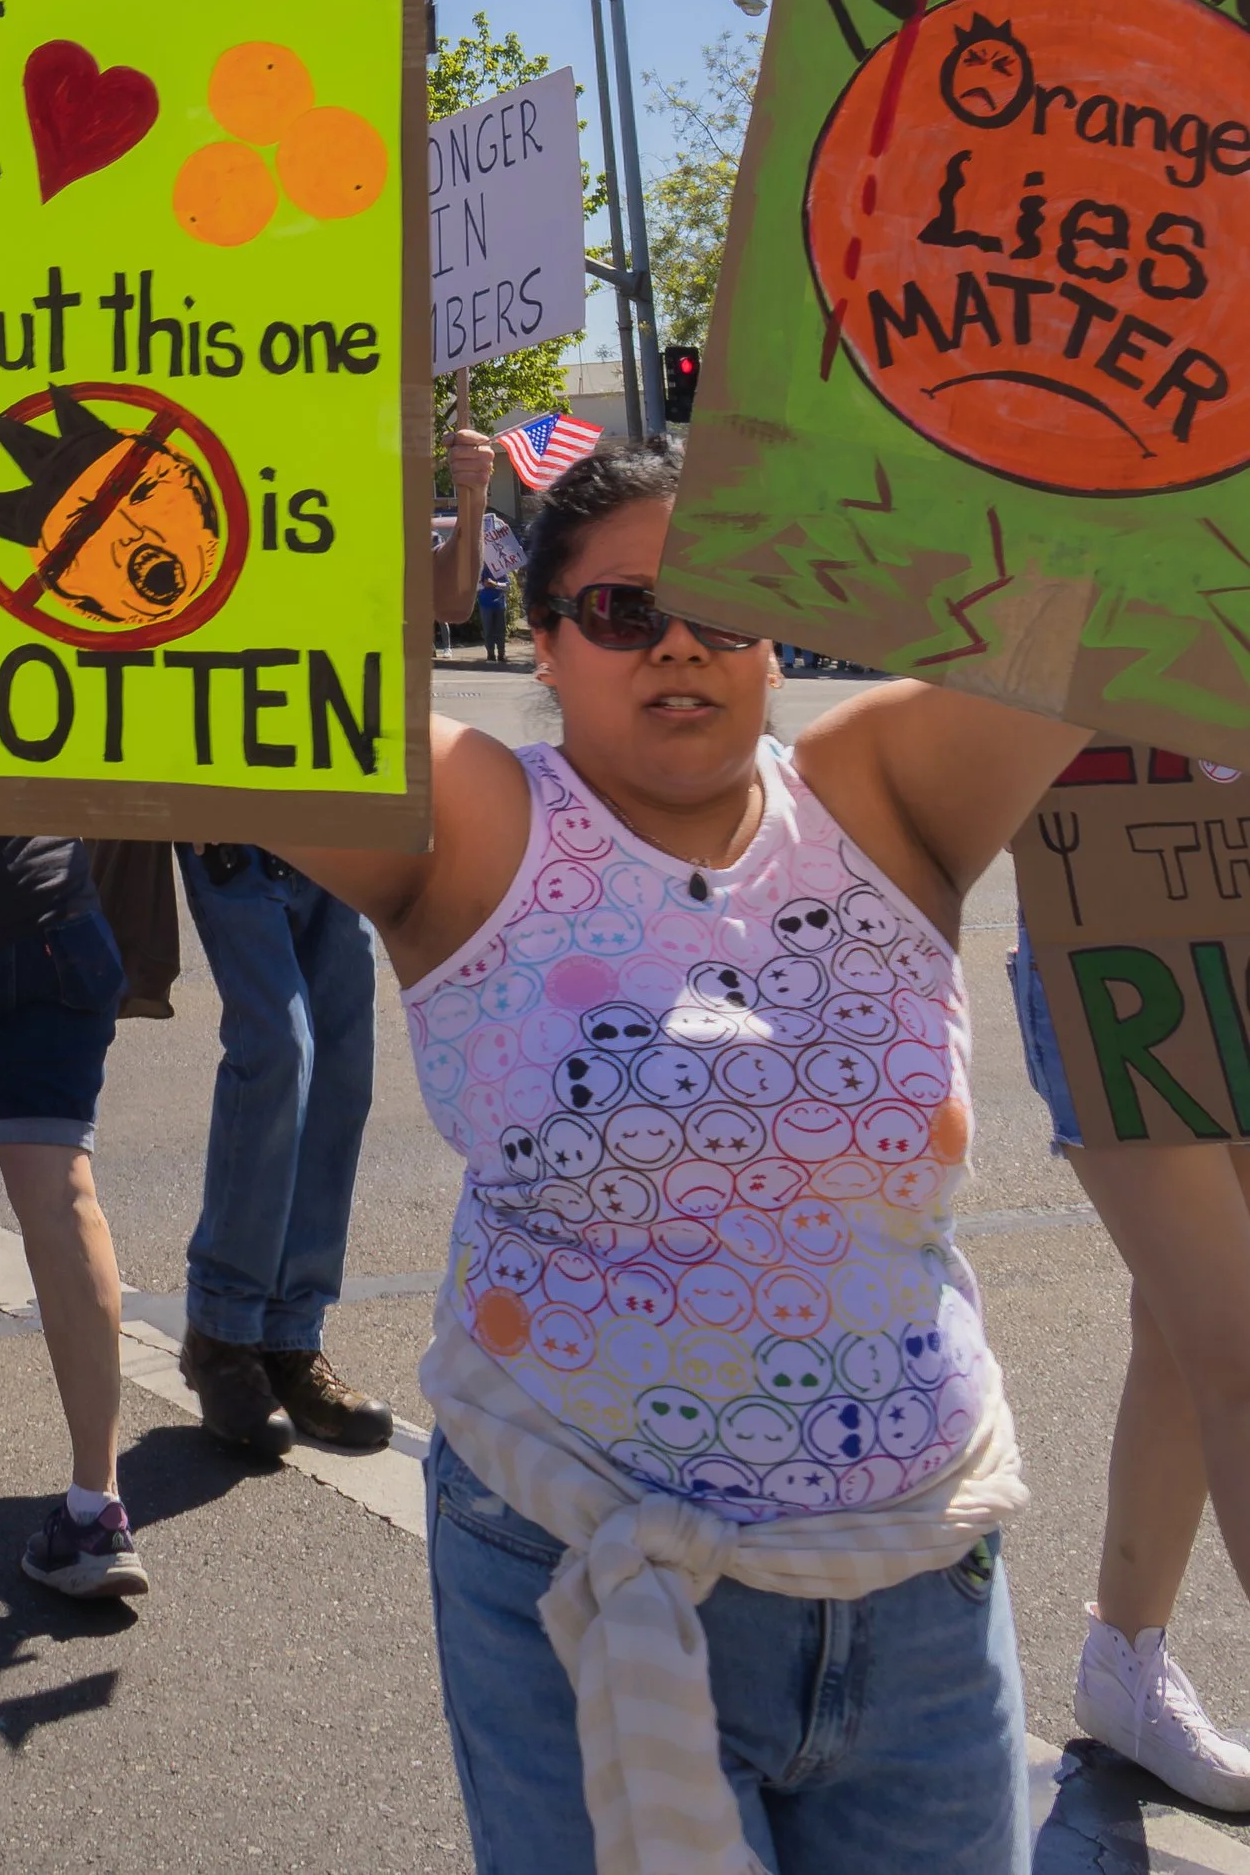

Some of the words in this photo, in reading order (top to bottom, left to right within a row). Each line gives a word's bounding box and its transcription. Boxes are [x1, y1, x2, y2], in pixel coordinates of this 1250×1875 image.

[940, 25, 1250, 189] Orange
[917, 148, 1209, 302] Lies
[100, 270, 244, 377] this
[259, 320, 380, 375] one
[867, 270, 1229, 444] MATTER
[259, 466, 335, 554] is
[1067, 941, 1250, 1142] RI
